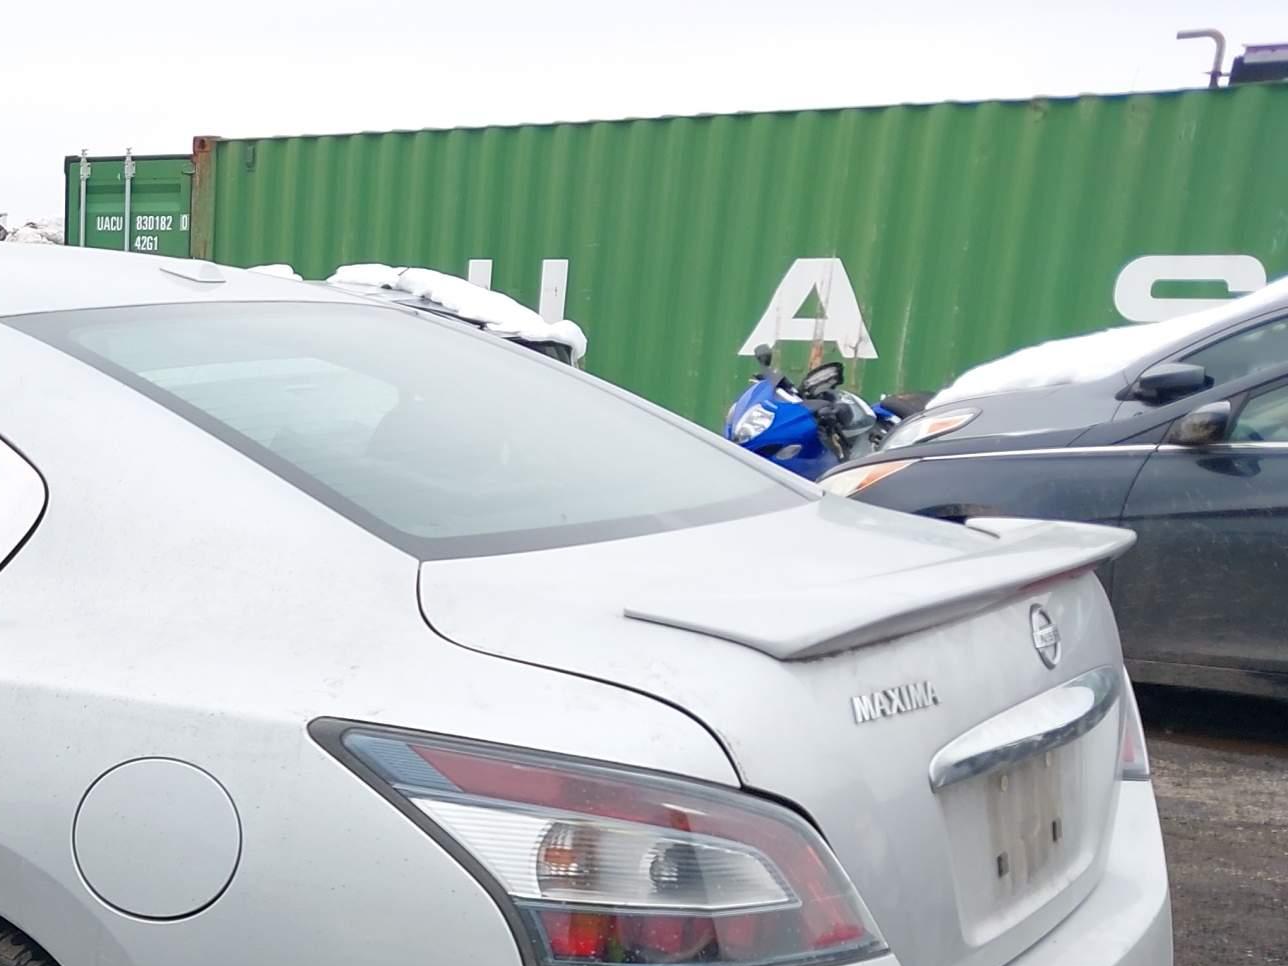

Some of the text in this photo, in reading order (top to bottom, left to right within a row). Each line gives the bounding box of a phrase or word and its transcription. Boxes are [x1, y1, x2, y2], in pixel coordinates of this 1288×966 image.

[96, 216, 123, 231] UACU
[136, 215, 172, 231] 830182
[134, 236, 158, 250] 42G1
[850, 681, 942, 723] MAXIMA
